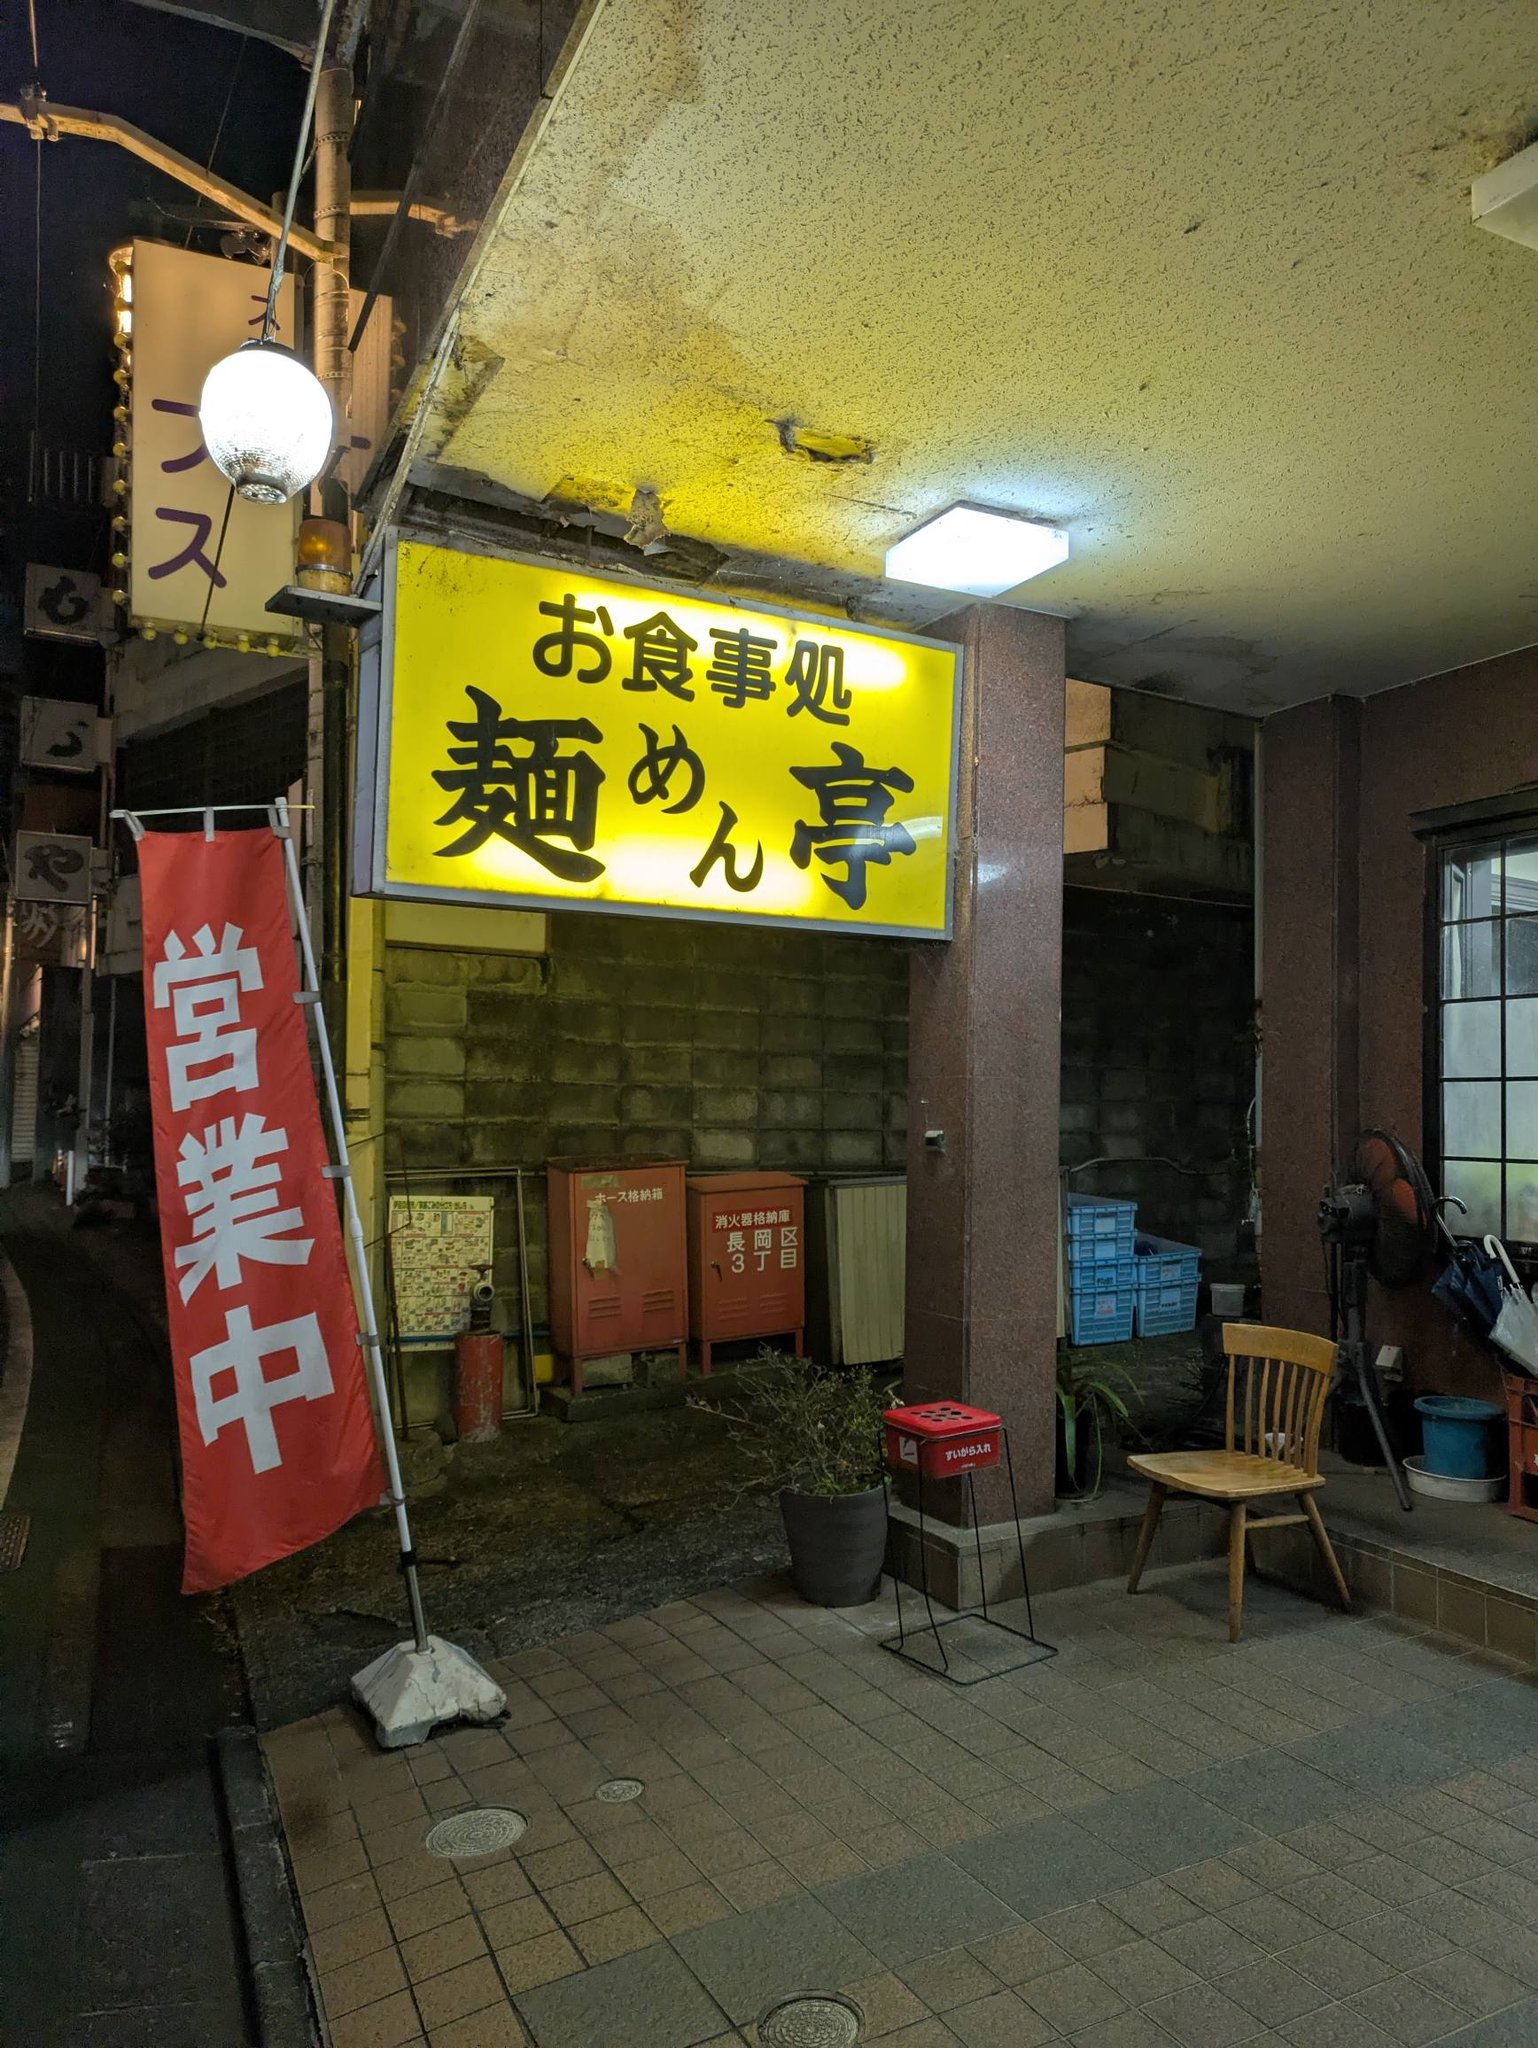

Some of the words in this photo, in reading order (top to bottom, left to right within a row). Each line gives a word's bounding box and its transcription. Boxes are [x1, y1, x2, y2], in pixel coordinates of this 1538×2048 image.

[532, 592, 852, 726] お食事処
[153, 921, 335, 1475] 営業中
[594, 1187, 663, 1203] ホース格納箱
[715, 1208, 790, 1230] 消火器格納庫
[944, 1443, 991, 1461] すいがら入れ
